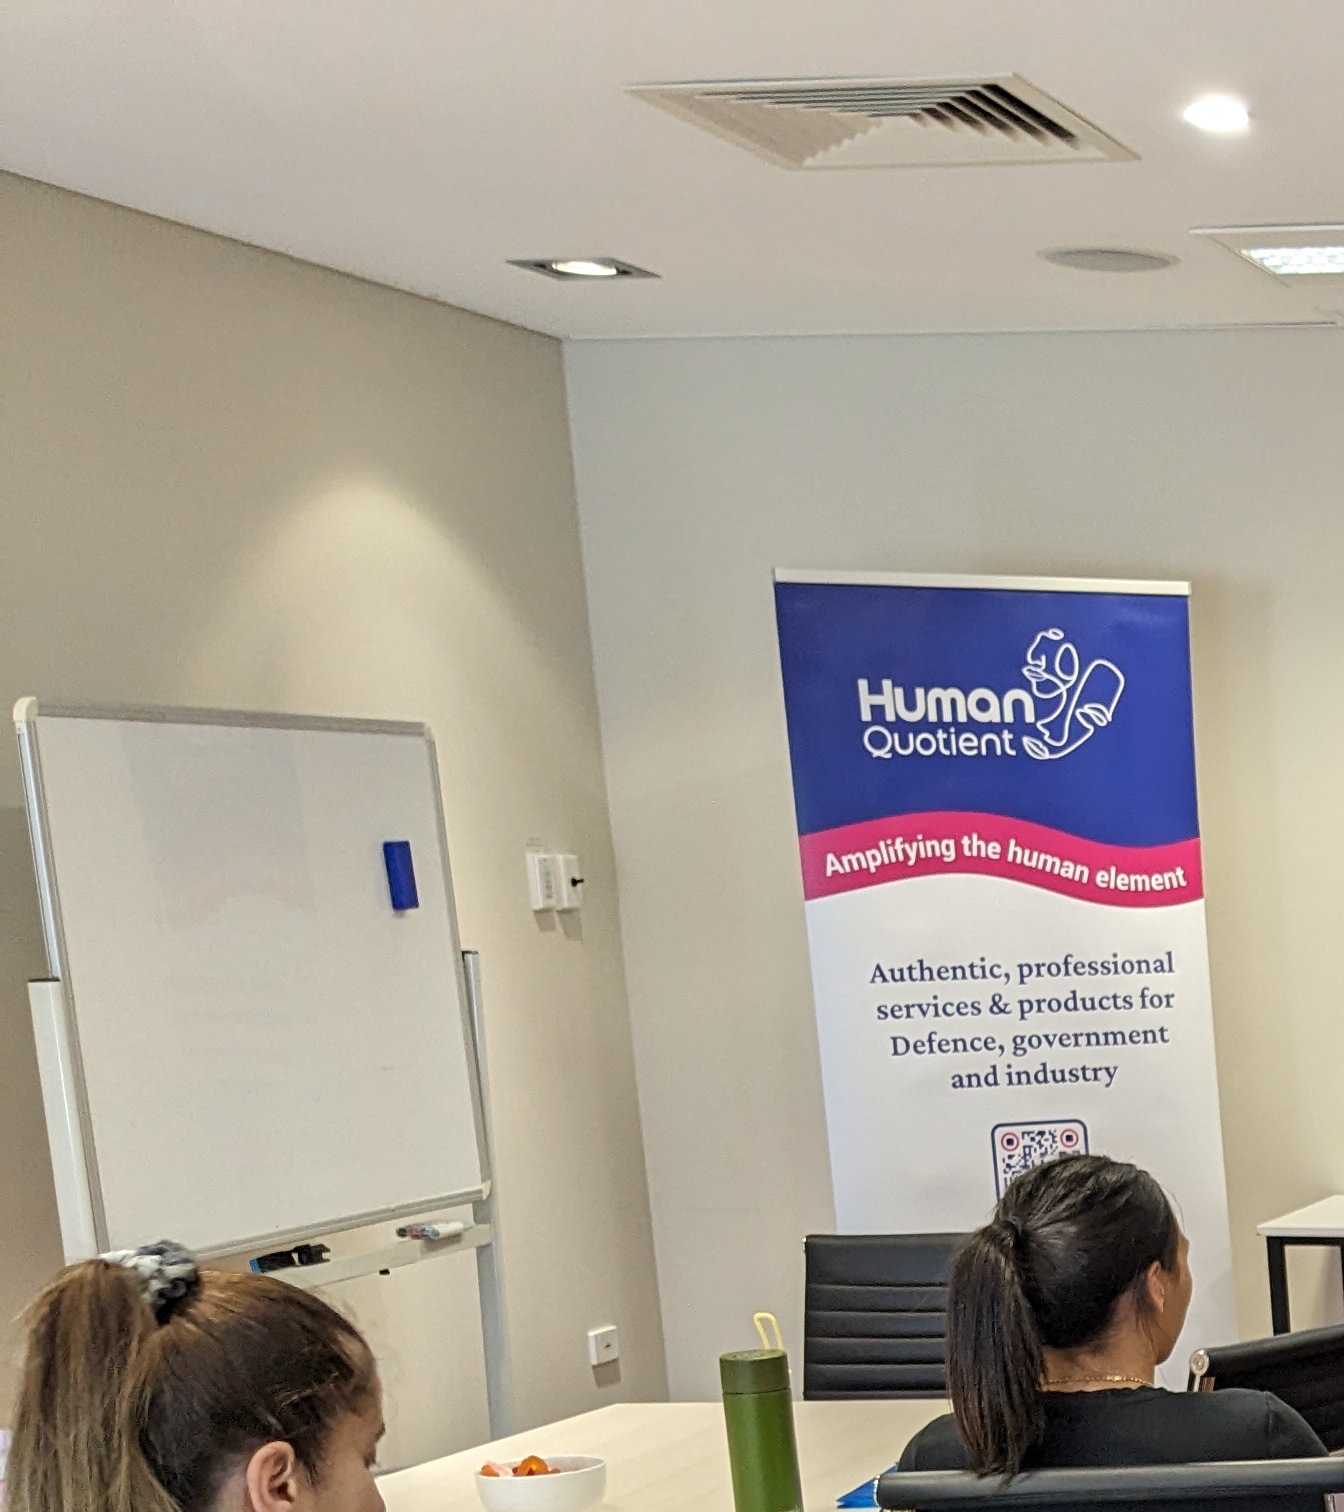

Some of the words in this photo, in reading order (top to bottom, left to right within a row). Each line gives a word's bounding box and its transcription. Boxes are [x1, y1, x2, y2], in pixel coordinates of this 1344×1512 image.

[857, 678, 1036, 723] Human
[863, 726, 1016, 759] Quotient
[824, 834, 956, 877] Amplifying
[961, 834, 1001, 859] the
[1007, 840, 1090, 884] human
[1095, 867, 1187, 892] element
[869, 956, 1011, 985] Authentic,
[1017, 951, 1176, 985] professional
[876, 994, 982, 1021] services
[988, 994, 1013, 1016] &
[1018, 988, 1134, 1021] products
[1140, 986, 1176, 1011] for
[890, 1033, 1006, 1058] Defence,
[1012, 1023, 1170, 1057] government
[951, 1064, 999, 1090] and
[1005, 1061, 1119, 1088] industry
